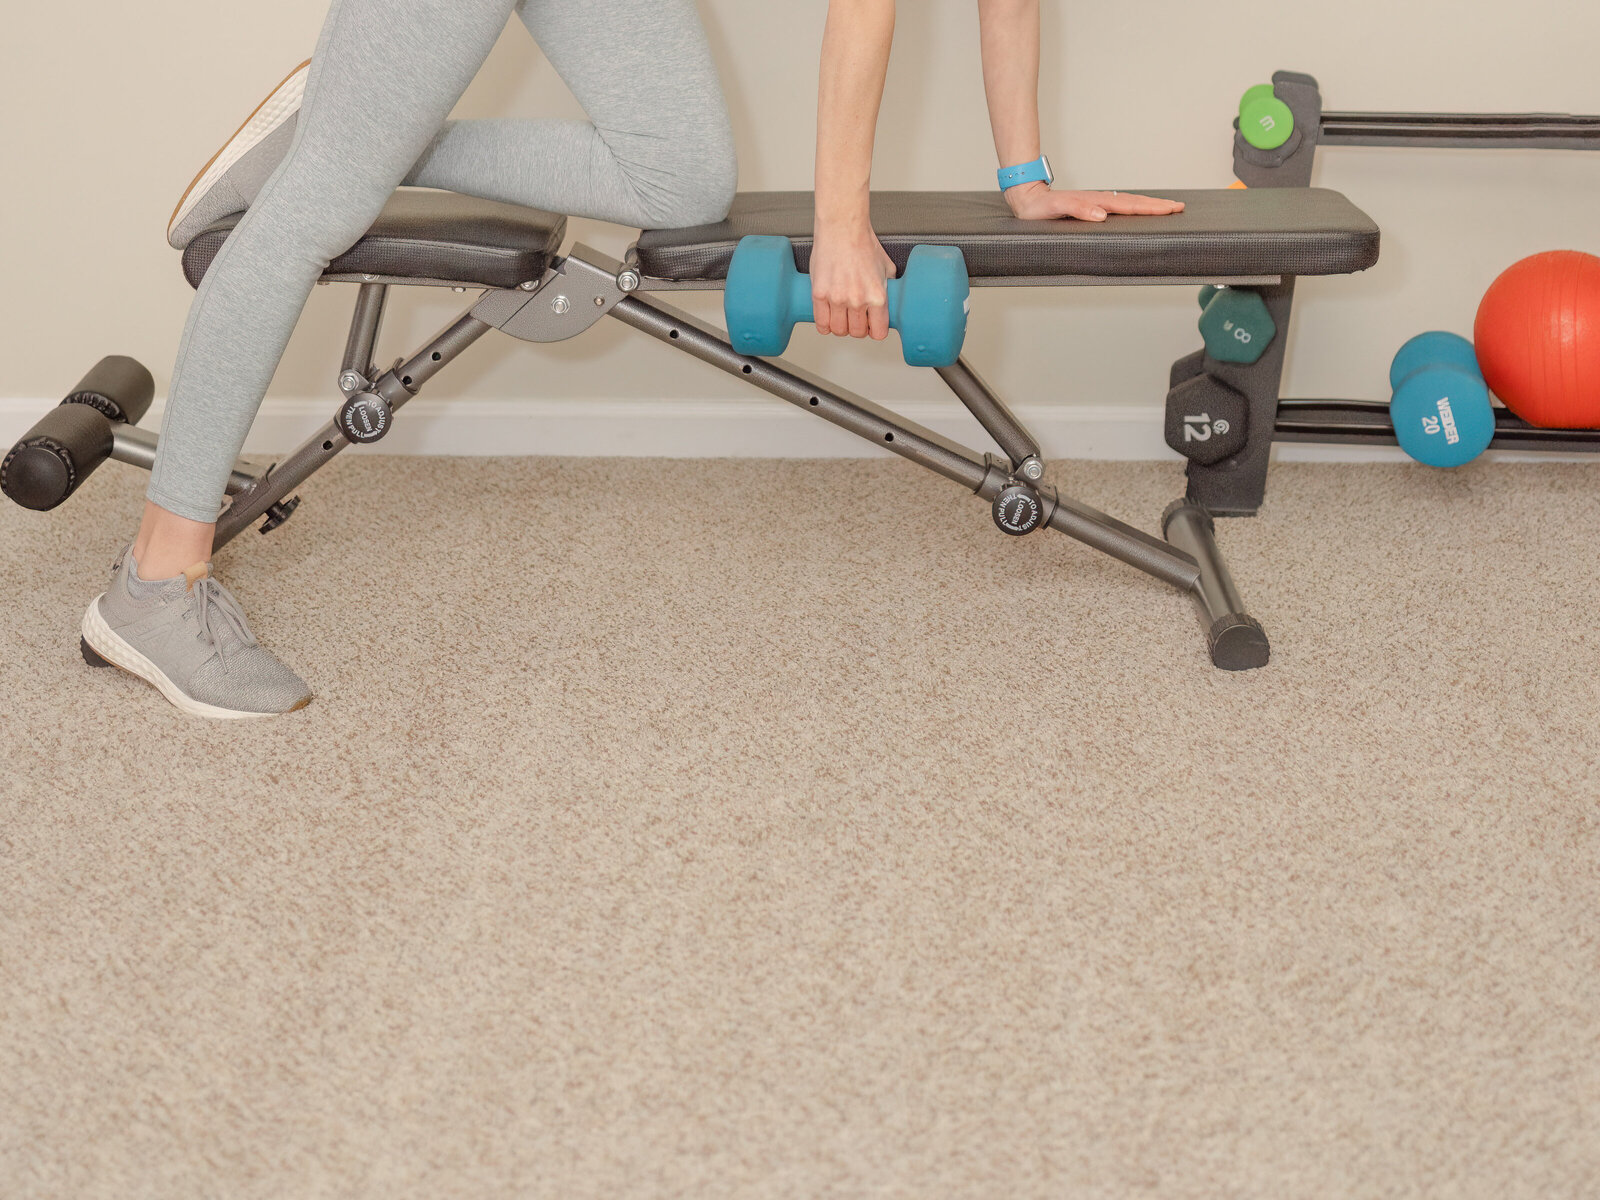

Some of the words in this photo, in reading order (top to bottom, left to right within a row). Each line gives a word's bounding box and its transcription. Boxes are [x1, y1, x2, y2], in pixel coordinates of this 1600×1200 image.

[1234, 328, 1252, 344] 8
[345, 406, 356, 426] THEN
[359, 406, 373, 432] LOOSEN
[368, 400, 377, 409] TO
[375, 406, 386, 434] ADJUST
[1421, 415, 1440, 435] 20
[1436, 396, 1460, 445] WEIDER
[348, 424, 365, 438] PULL
[1184, 412, 1212, 442] 12
[999, 493, 1017, 508] THEN
[1028, 499, 1037, 509] TO
[998, 507, 1008, 526] PULL
[1011, 500, 1025, 525] LOOSEN
[1018, 510, 1038, 531] ADJUST
